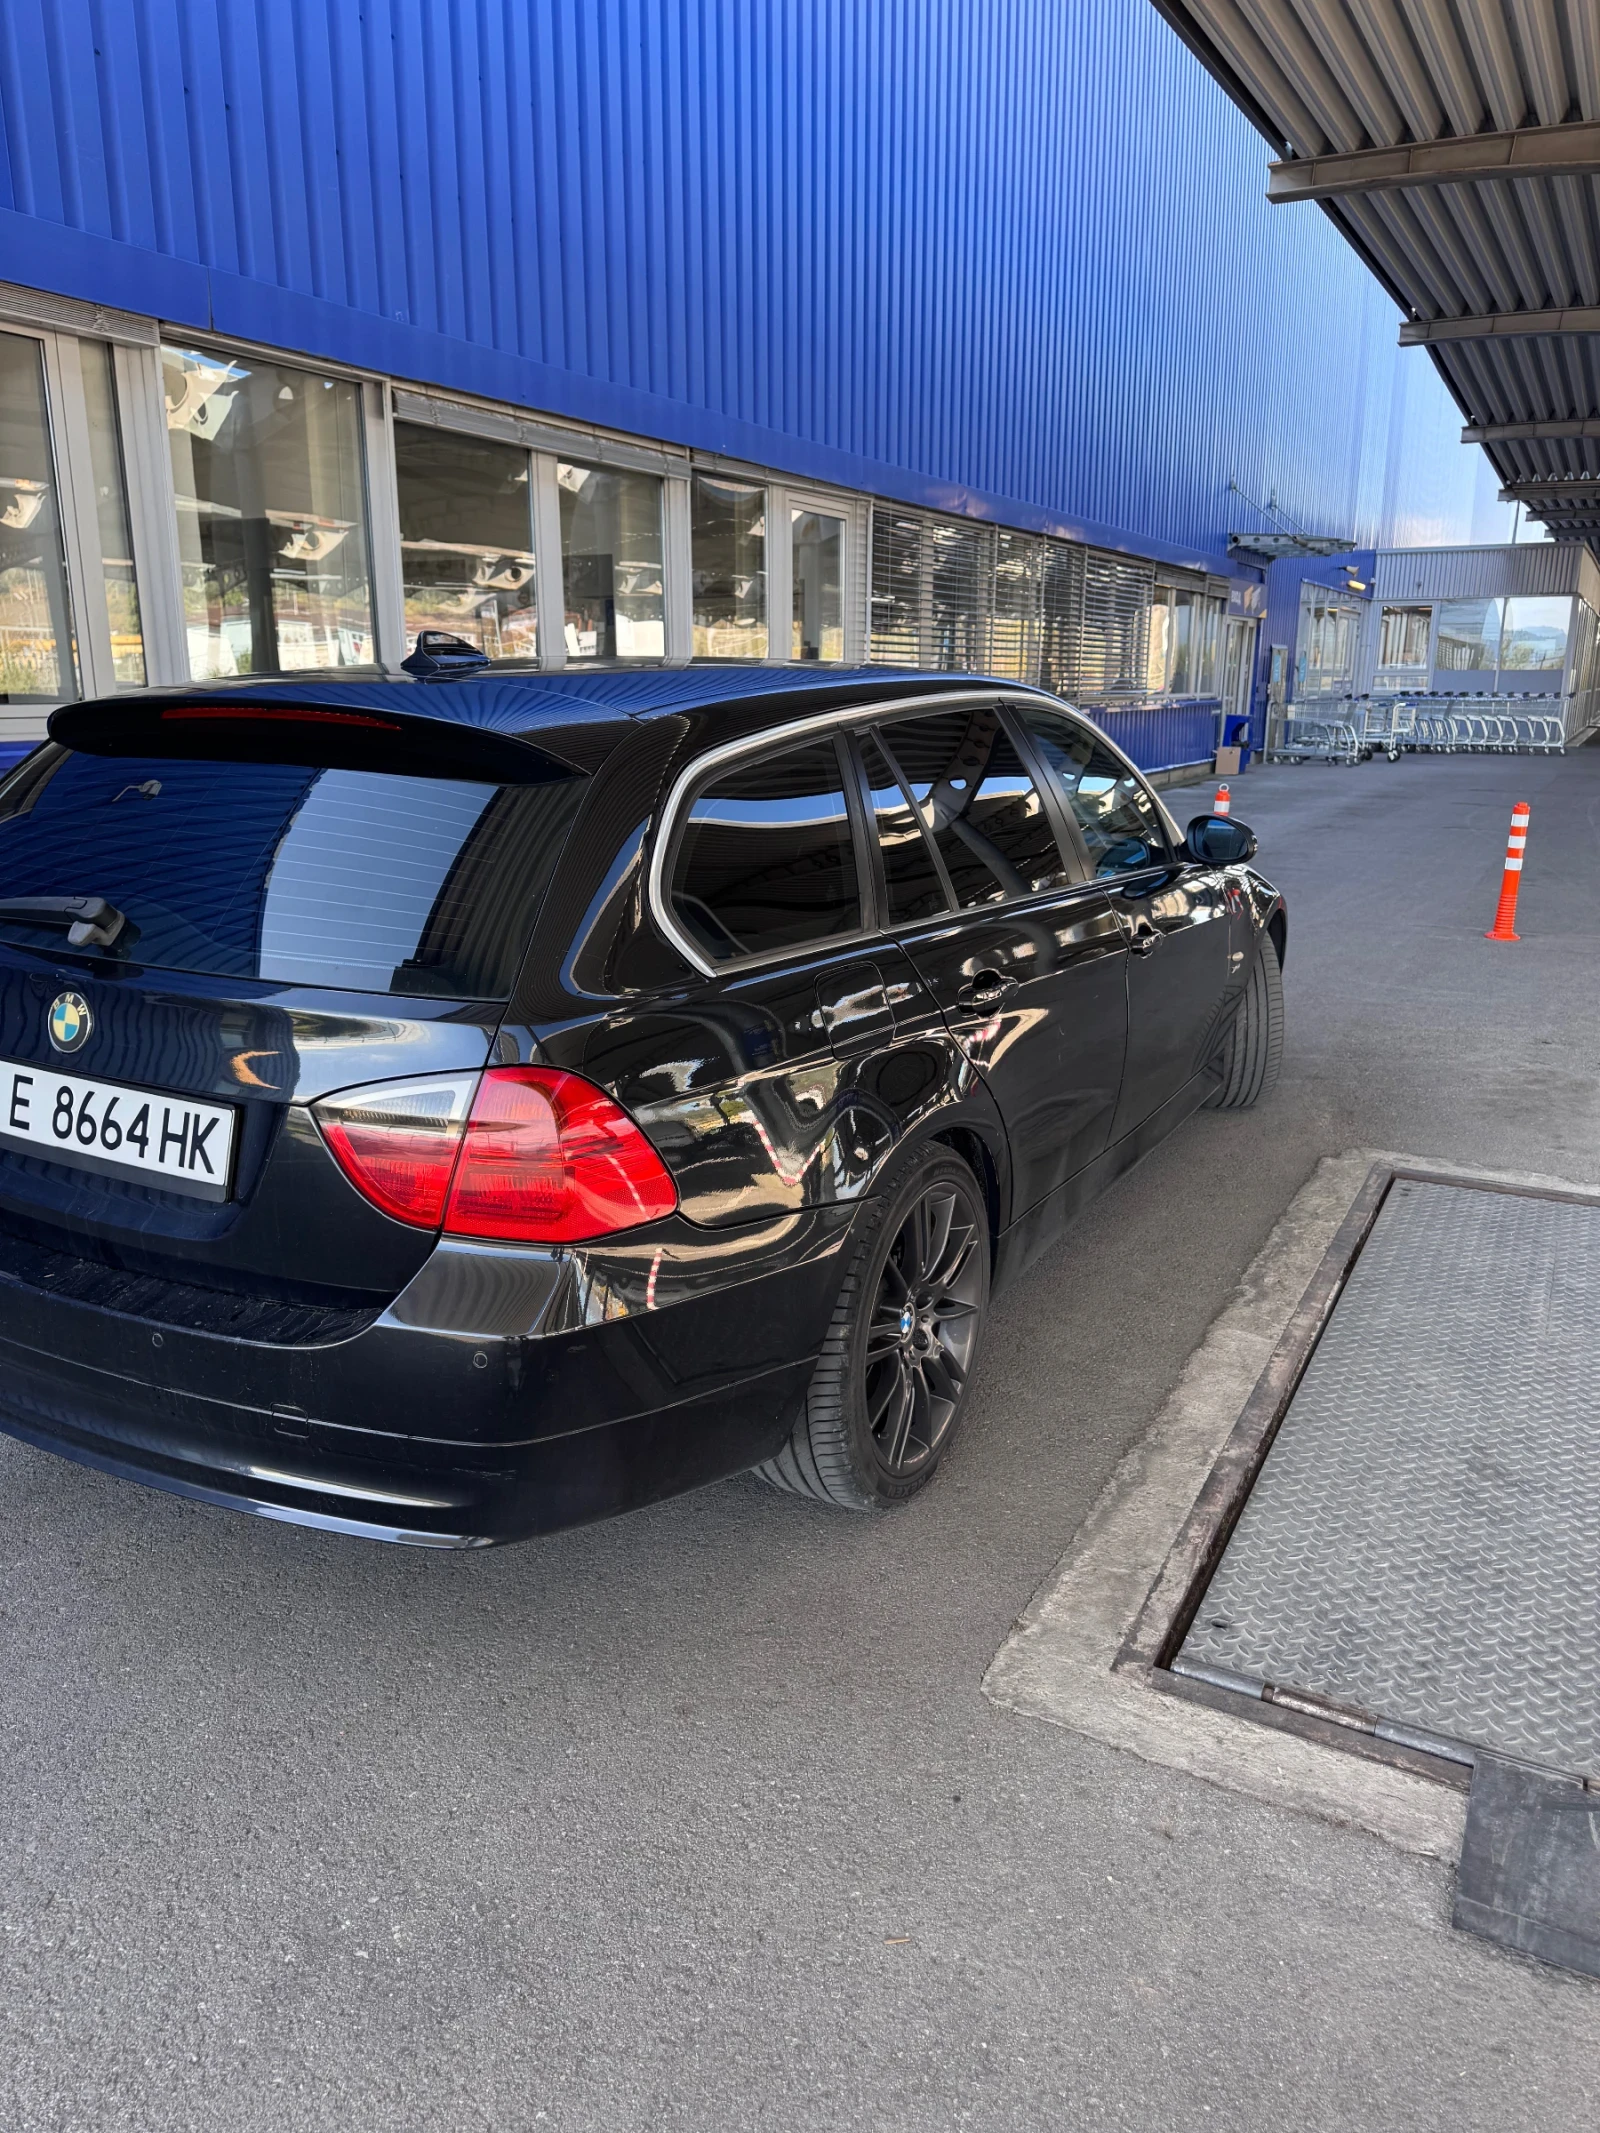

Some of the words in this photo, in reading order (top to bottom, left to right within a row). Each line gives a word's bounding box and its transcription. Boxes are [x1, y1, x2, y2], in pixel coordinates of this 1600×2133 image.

[53, 993, 87, 1016] BMW
[9, 1074, 34, 1131] E
[52, 1085, 150, 1159] 8664
[158, 1107, 220, 1175] HK
